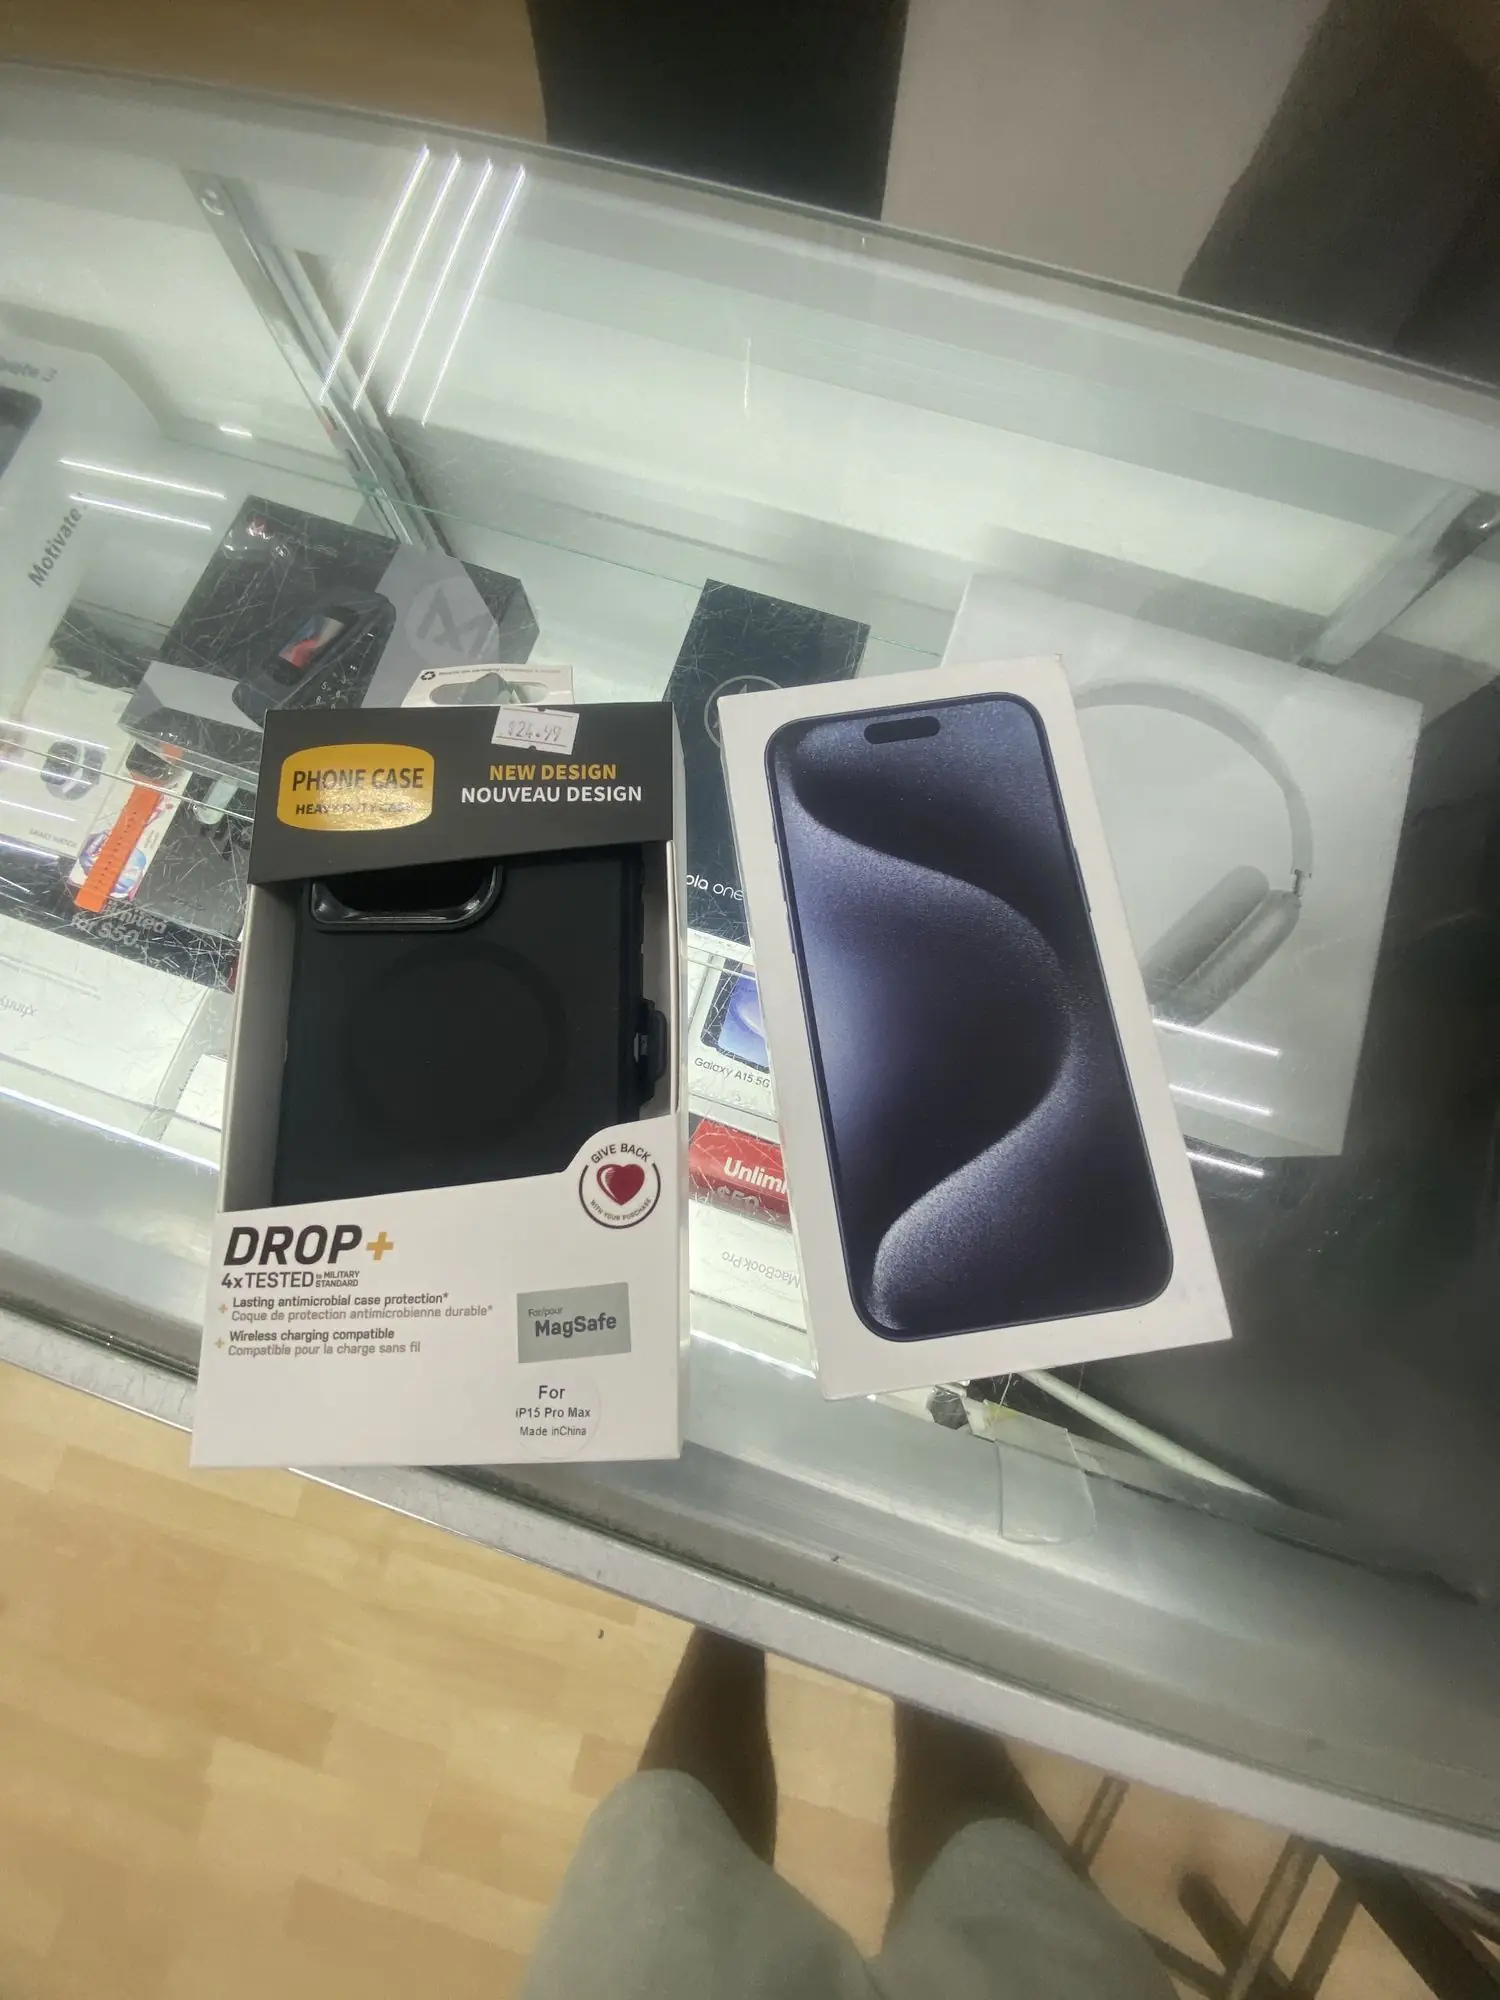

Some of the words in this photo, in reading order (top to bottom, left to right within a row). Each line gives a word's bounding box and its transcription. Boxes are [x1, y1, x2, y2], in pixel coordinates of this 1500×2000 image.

[28, 508, 82, 588] Motivate
[292, 768, 367, 792] PHONE
[371, 768, 425, 790] CASE
[489, 764, 536, 781] NEW
[541, 763, 617, 780] DESIGN
[461, 786, 560, 803] NOUVEAU
[566, 785, 642, 802] DESIGN
[694, 1057, 733, 1080] Galaxy
[734, 1070, 754, 1083] A15
[755, 1077, 771, 1089] 5G
[591, 1144, 617, 1164] GIVE
[620, 1143, 652, 1163] BACK
[721, 1251, 743, 1268] Pro
[323, 1270, 360, 1279] MILITARY
[743, 1257, 800, 1288] MacBook
[315, 1279, 359, 1288] STANDARD
[232, 1297, 275, 1310] Lasting
[278, 1295, 351, 1307] antimicrobial
[354, 1296, 381, 1305] case
[231, 1310, 268, 1323] Coque
[270, 1309, 285, 1321] de
[287, 1309, 347, 1323] protection
[350, 1306, 442, 1319] antimicrobienne
[535, 1312, 617, 1338] MagSafe
[229, 1330, 277, 1341] Wireless
[280, 1329, 329, 1342] charging
[332, 1327, 395, 1342] compatible
[228, 1344, 291, 1358] Compatible
[294, 1346, 320, 1358] pour
[323, 1343, 333, 1354] la
[336, 1343, 376, 1356] charge
[379, 1344, 406, 1353] sans
[410, 1341, 421, 1353] fil
[538, 1385, 566, 1399] For
[515, 1407, 541, 1418] iP15
[544, 1407, 565, 1418] Pro
[568, 1406, 591, 1418] Max
[520, 1426, 548, 1436] Made
